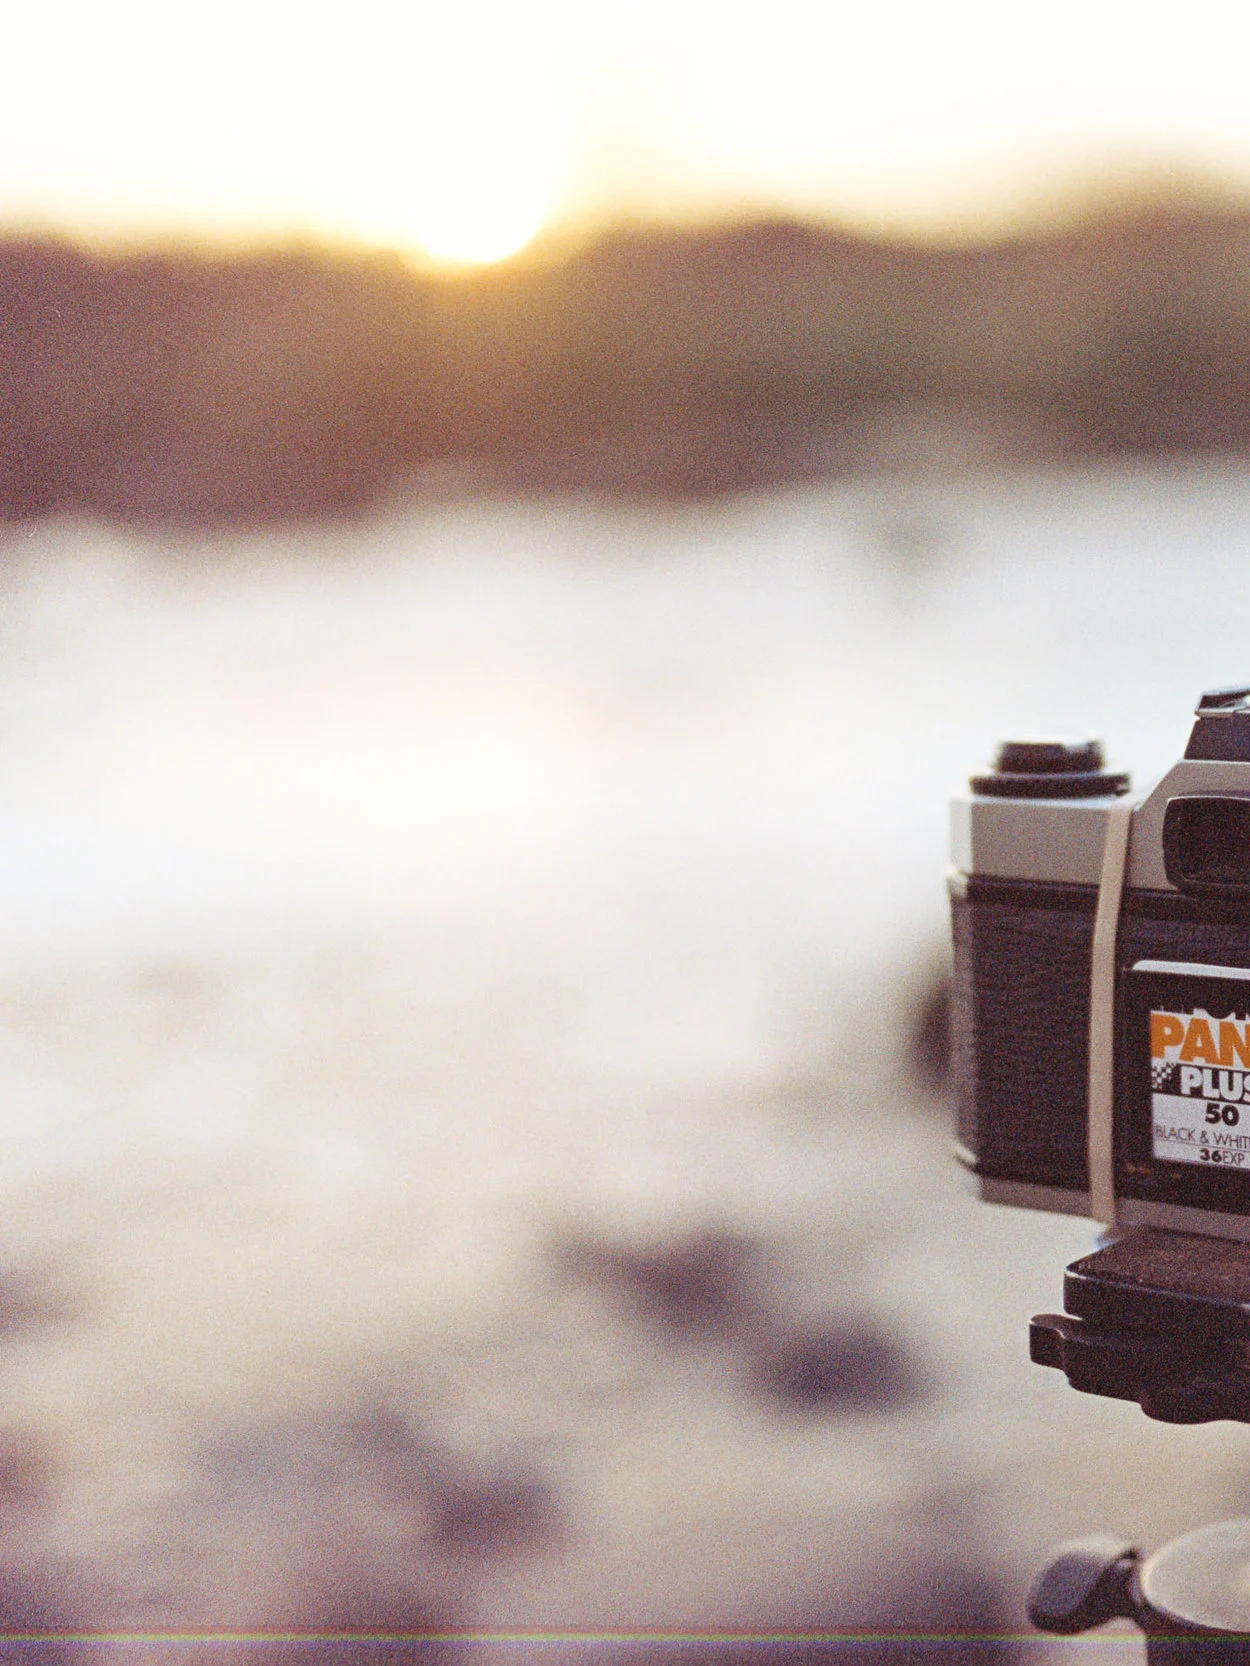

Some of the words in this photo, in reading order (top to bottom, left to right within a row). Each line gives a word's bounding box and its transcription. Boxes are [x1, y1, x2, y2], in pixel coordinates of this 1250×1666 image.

[1205, 1104, 1240, 1127] 50
[1155, 1125, 1196, 1142] BLACK
[1199, 1131, 1210, 1145] &
